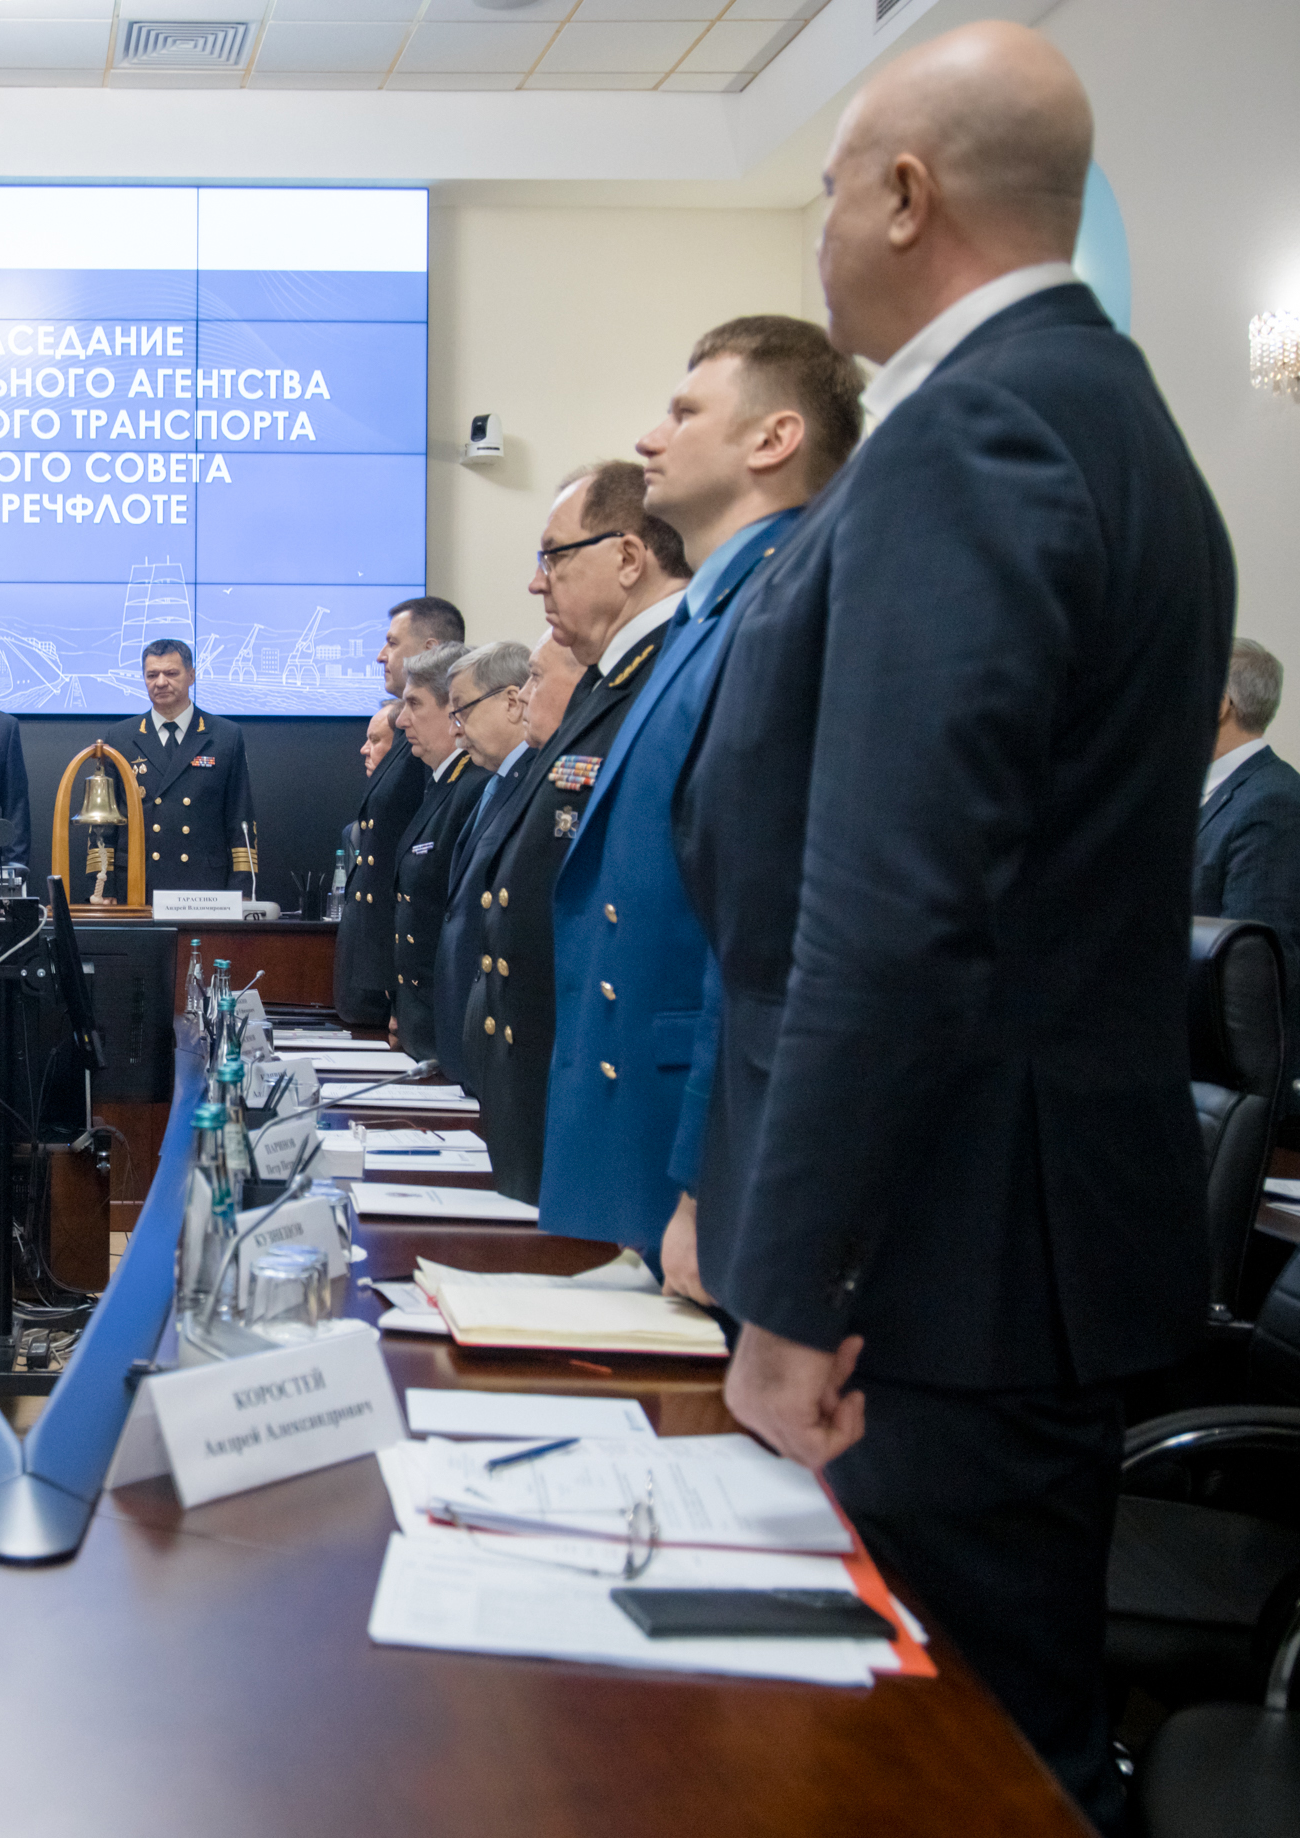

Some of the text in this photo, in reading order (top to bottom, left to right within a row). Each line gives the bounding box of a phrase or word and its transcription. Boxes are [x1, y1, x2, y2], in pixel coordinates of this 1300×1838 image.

[128, 368, 331, 400] АГЕНТСТВА
[71, 409, 317, 441] ТРАНСПОРТА
[85, 452, 232, 483] СОВЕТА
[232, 1366, 327, 1411] КОРОСТЕЙ
[205, 1400, 374, 1457] Андрей Александрович
